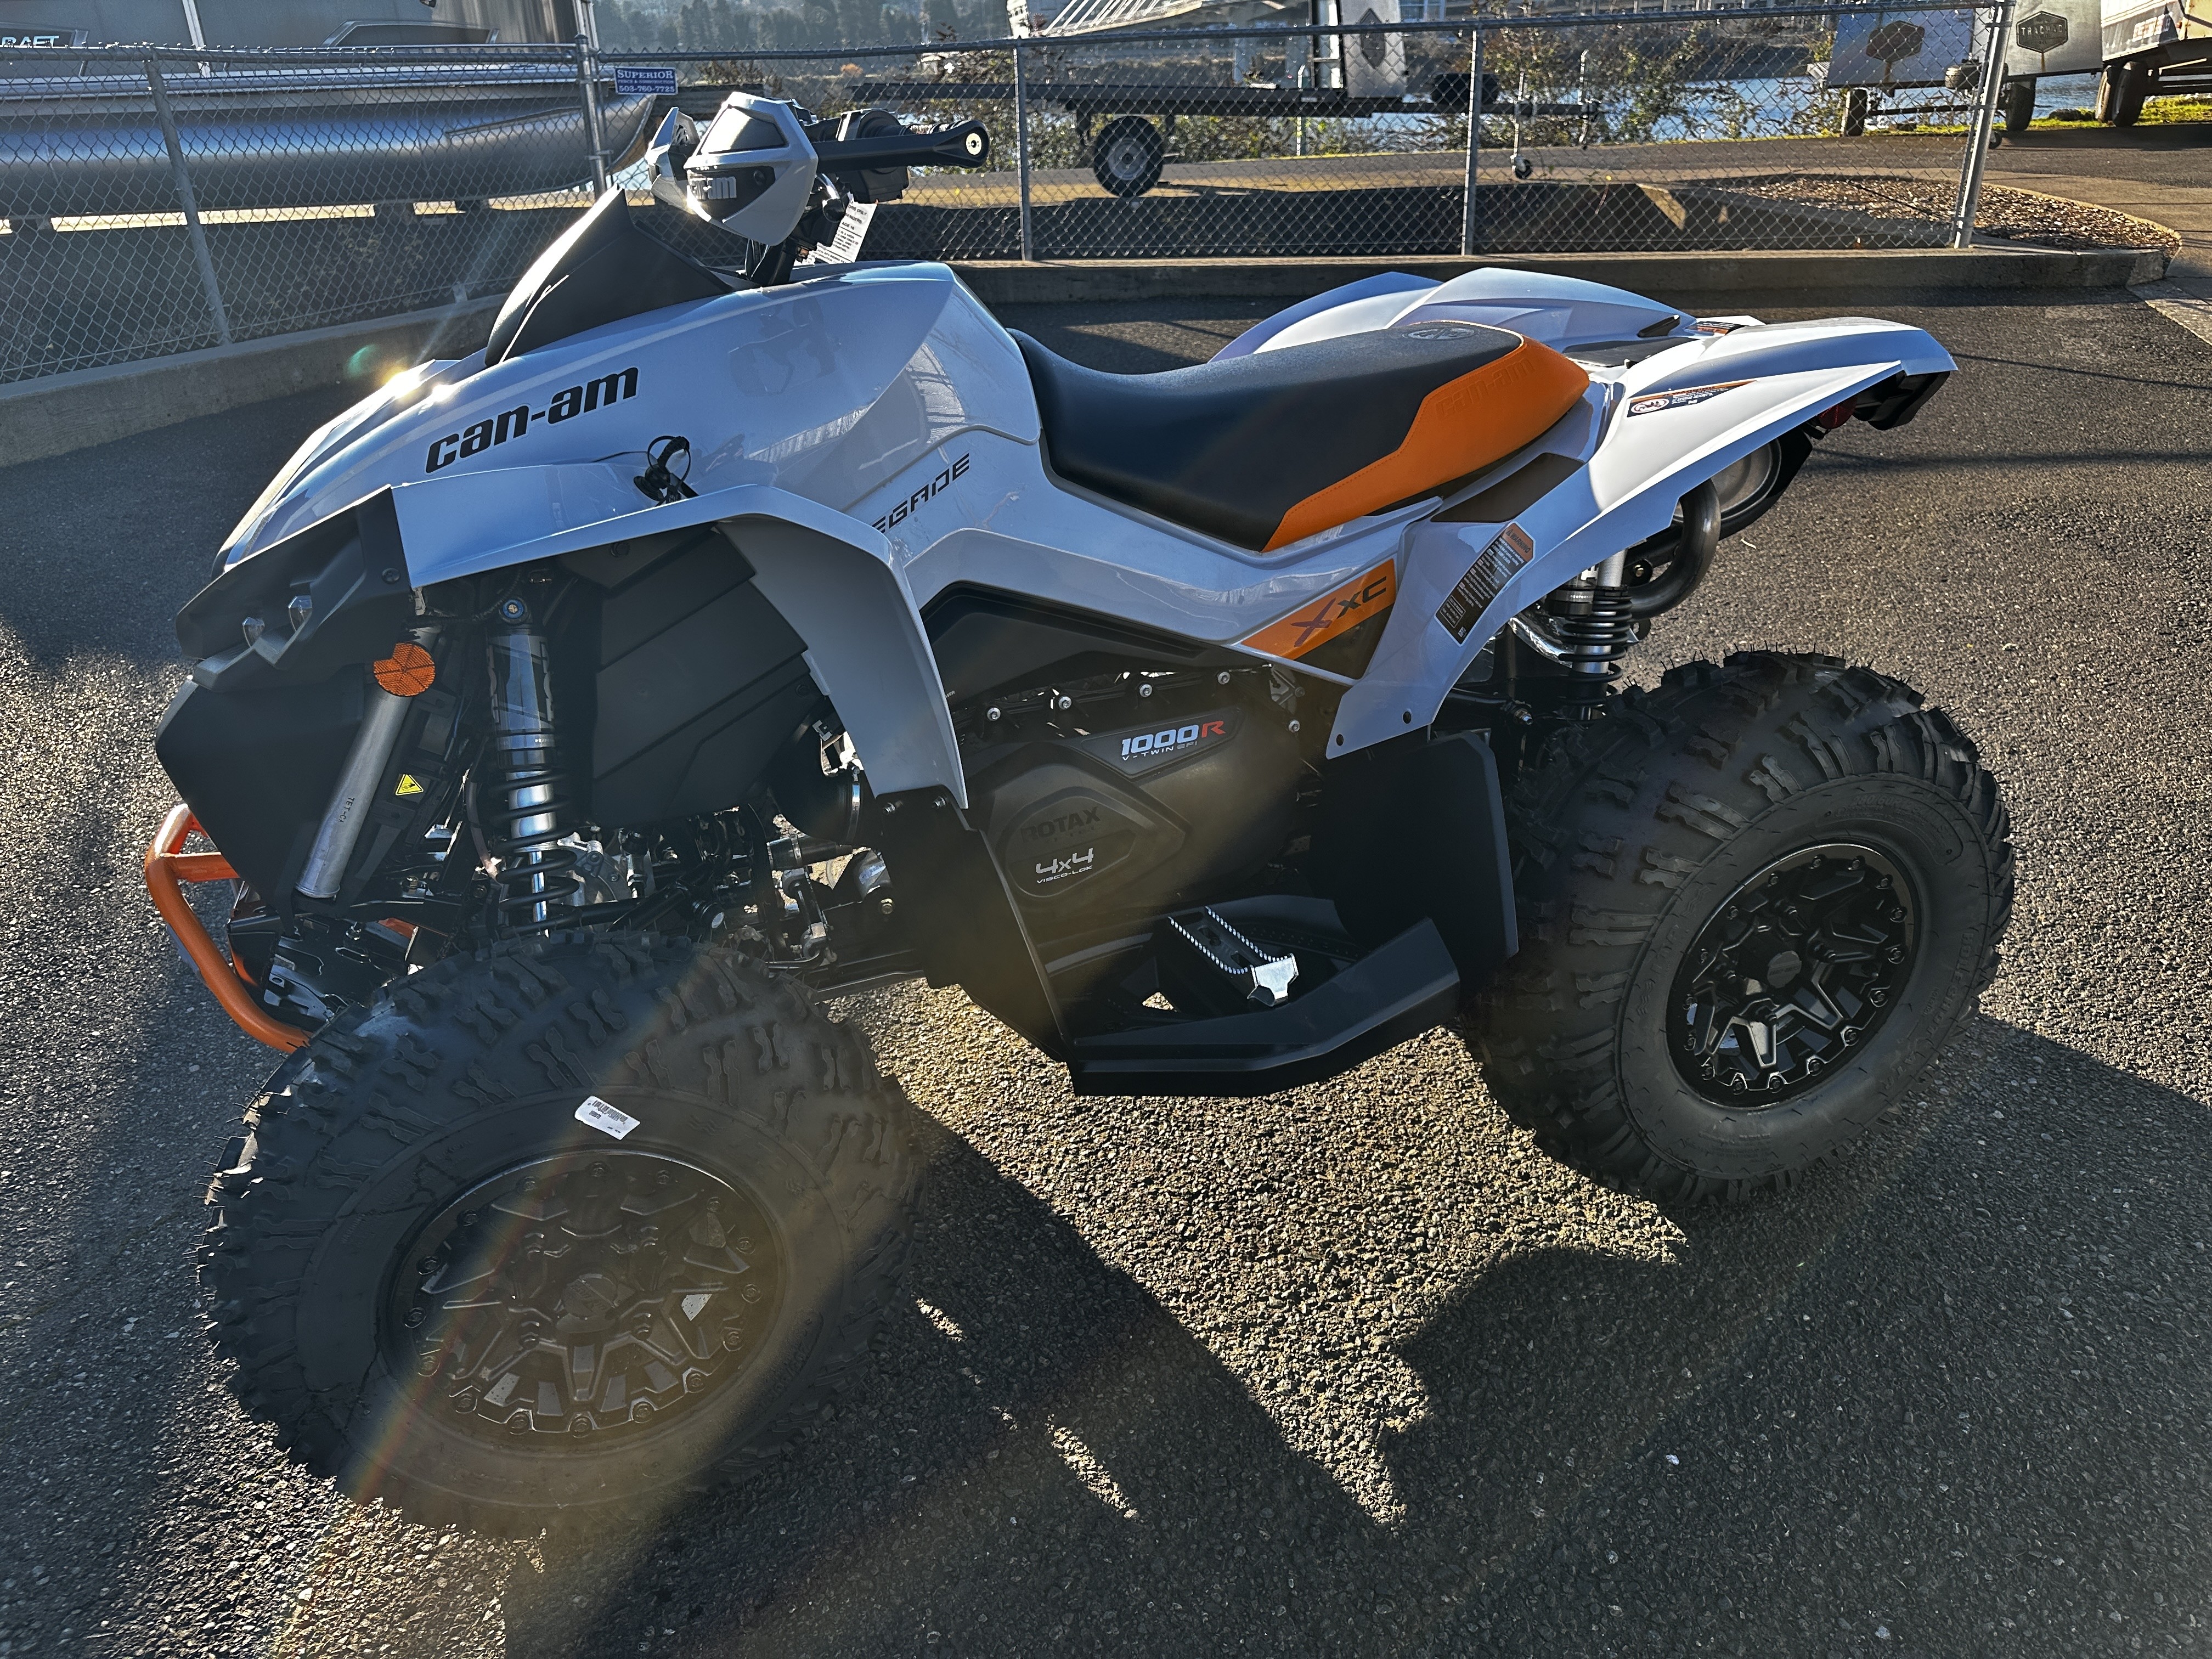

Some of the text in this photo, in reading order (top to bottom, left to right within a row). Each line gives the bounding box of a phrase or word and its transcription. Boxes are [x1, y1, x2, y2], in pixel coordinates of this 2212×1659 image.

[617, 69, 674, 79] SUPERIOR
[426, 367, 639, 473] can-am
[1510, 533, 1531, 554] WARNING
[1122, 746, 1174, 761] V-TWIN
[1020, 806, 1101, 843] ROTAX
[1036, 848, 1094, 874] 4x4
